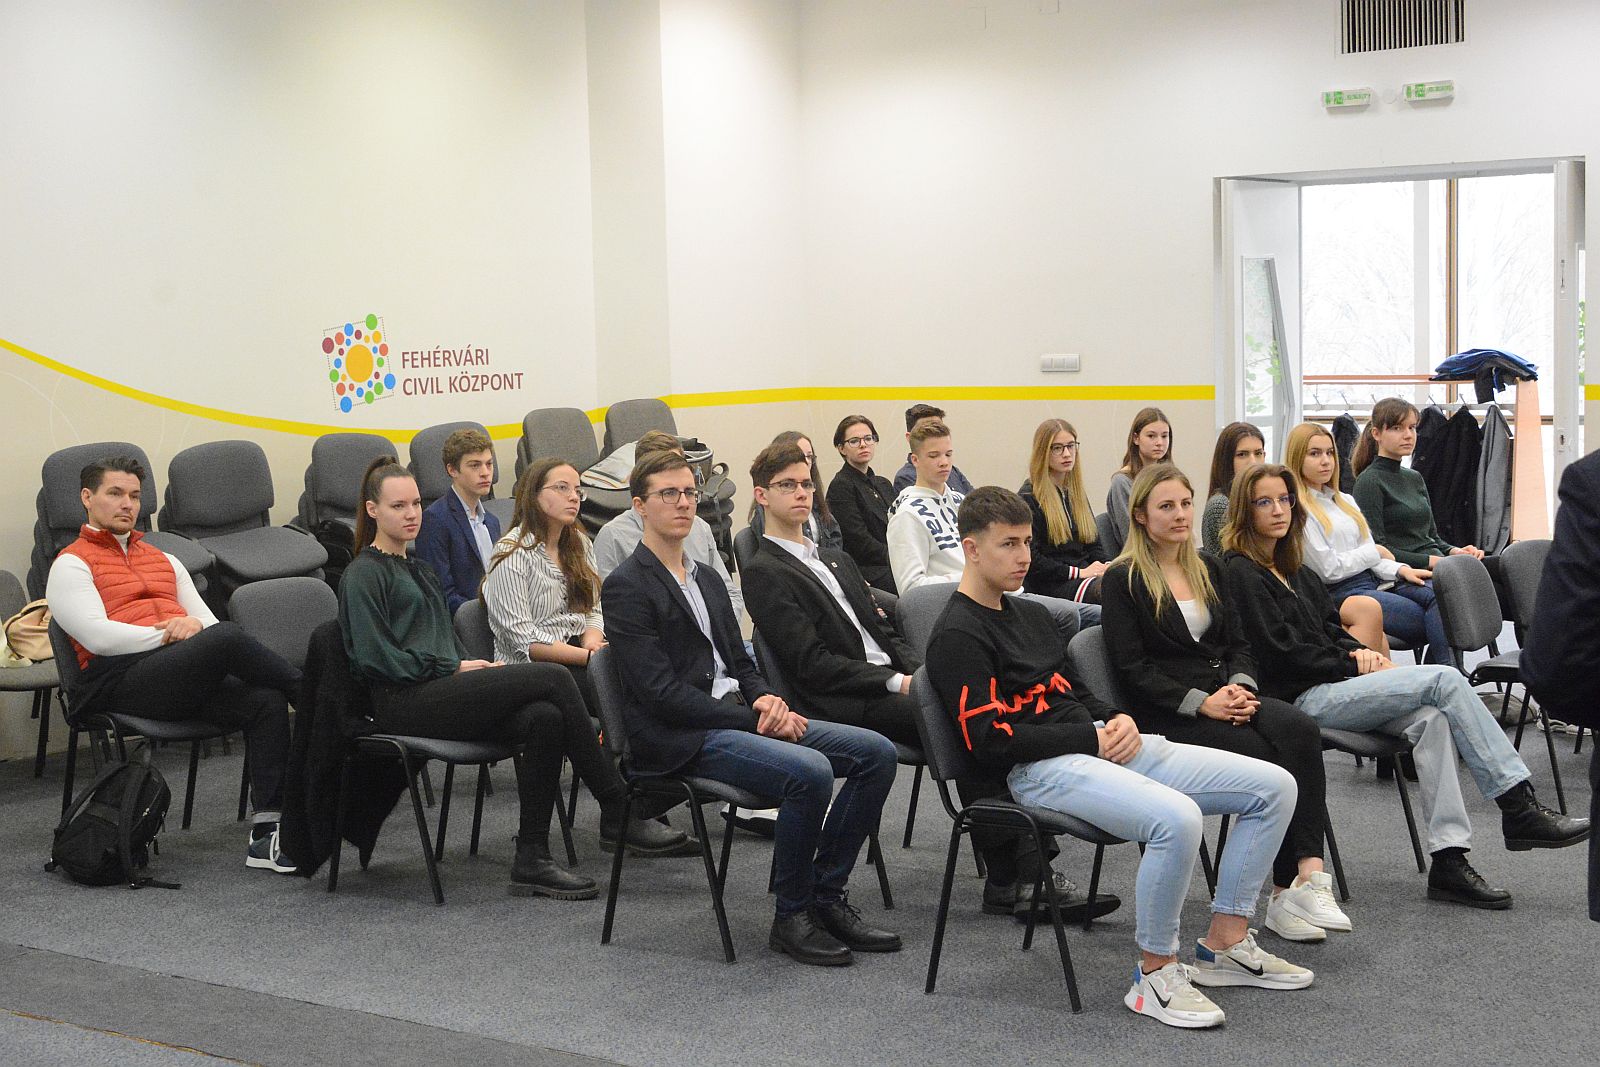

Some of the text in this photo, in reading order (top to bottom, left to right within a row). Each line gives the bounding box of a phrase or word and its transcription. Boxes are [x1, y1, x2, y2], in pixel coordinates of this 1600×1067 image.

[402, 344, 489, 369] FEHÉRVÁRI
[402, 370, 524, 396] CIVIL KÖZPONT
[909, 498, 958, 551] wall
